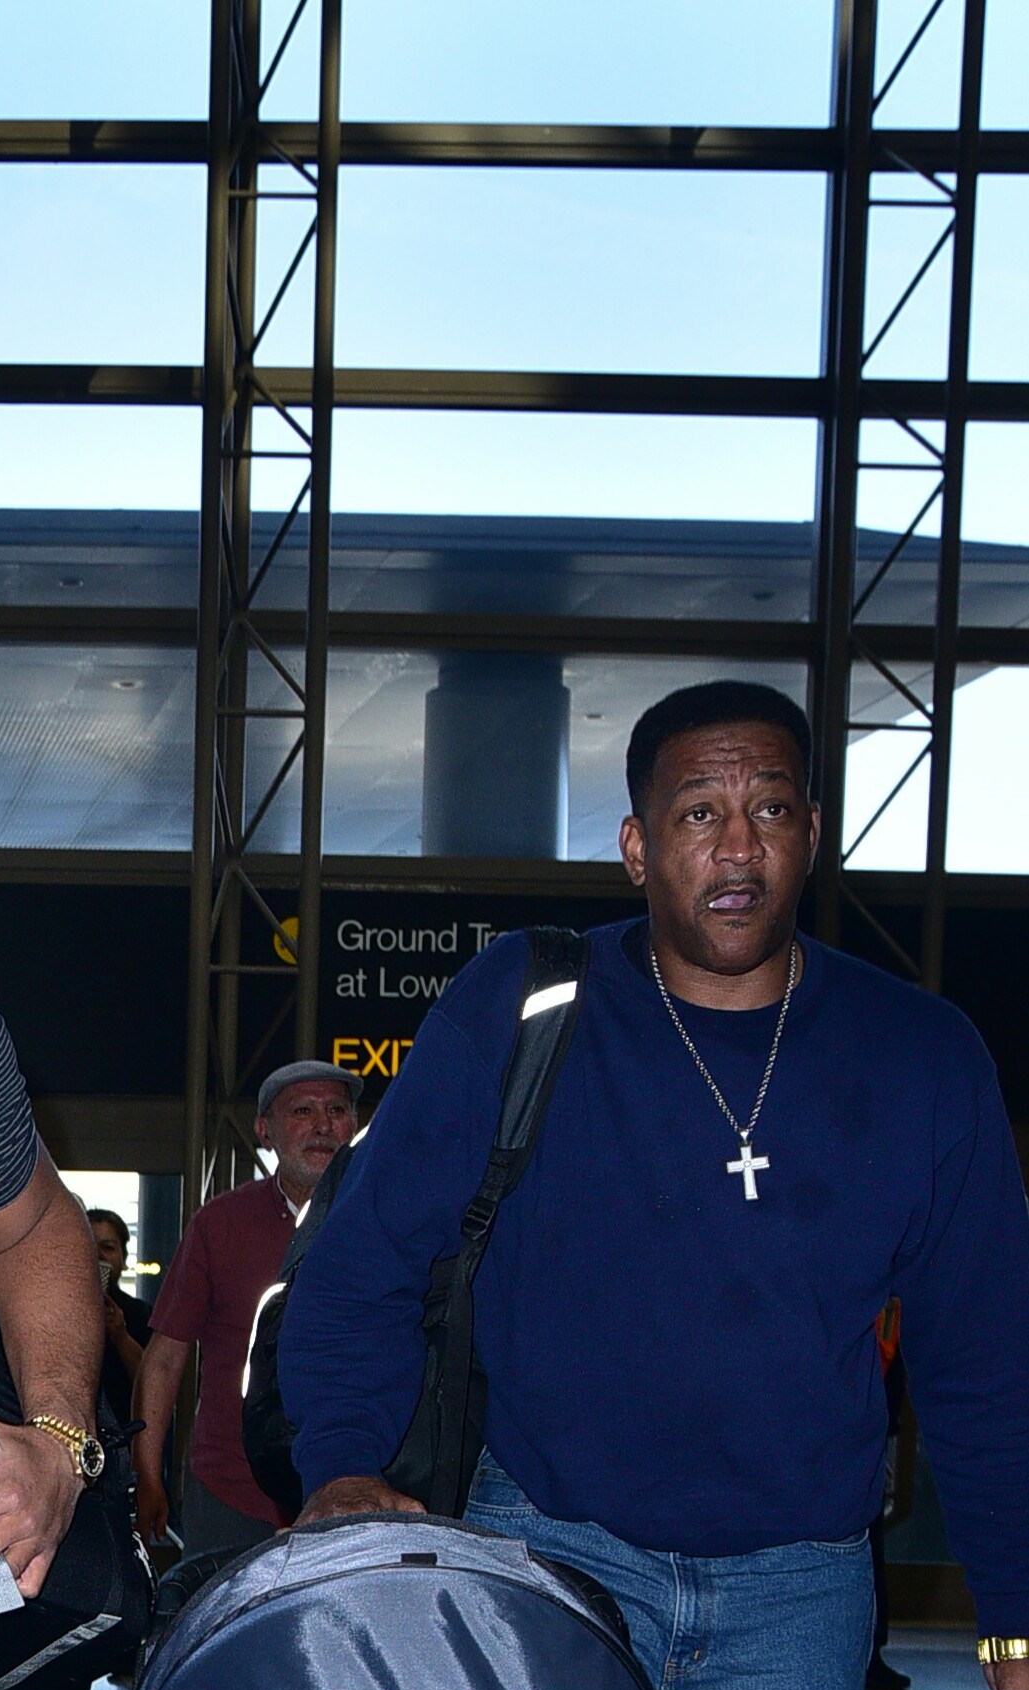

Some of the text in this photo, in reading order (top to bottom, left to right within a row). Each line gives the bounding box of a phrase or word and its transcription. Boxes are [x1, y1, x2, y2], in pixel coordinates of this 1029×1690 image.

[337, 919, 509, 953] Ground Tr
[336, 966, 455, 999] at Low
